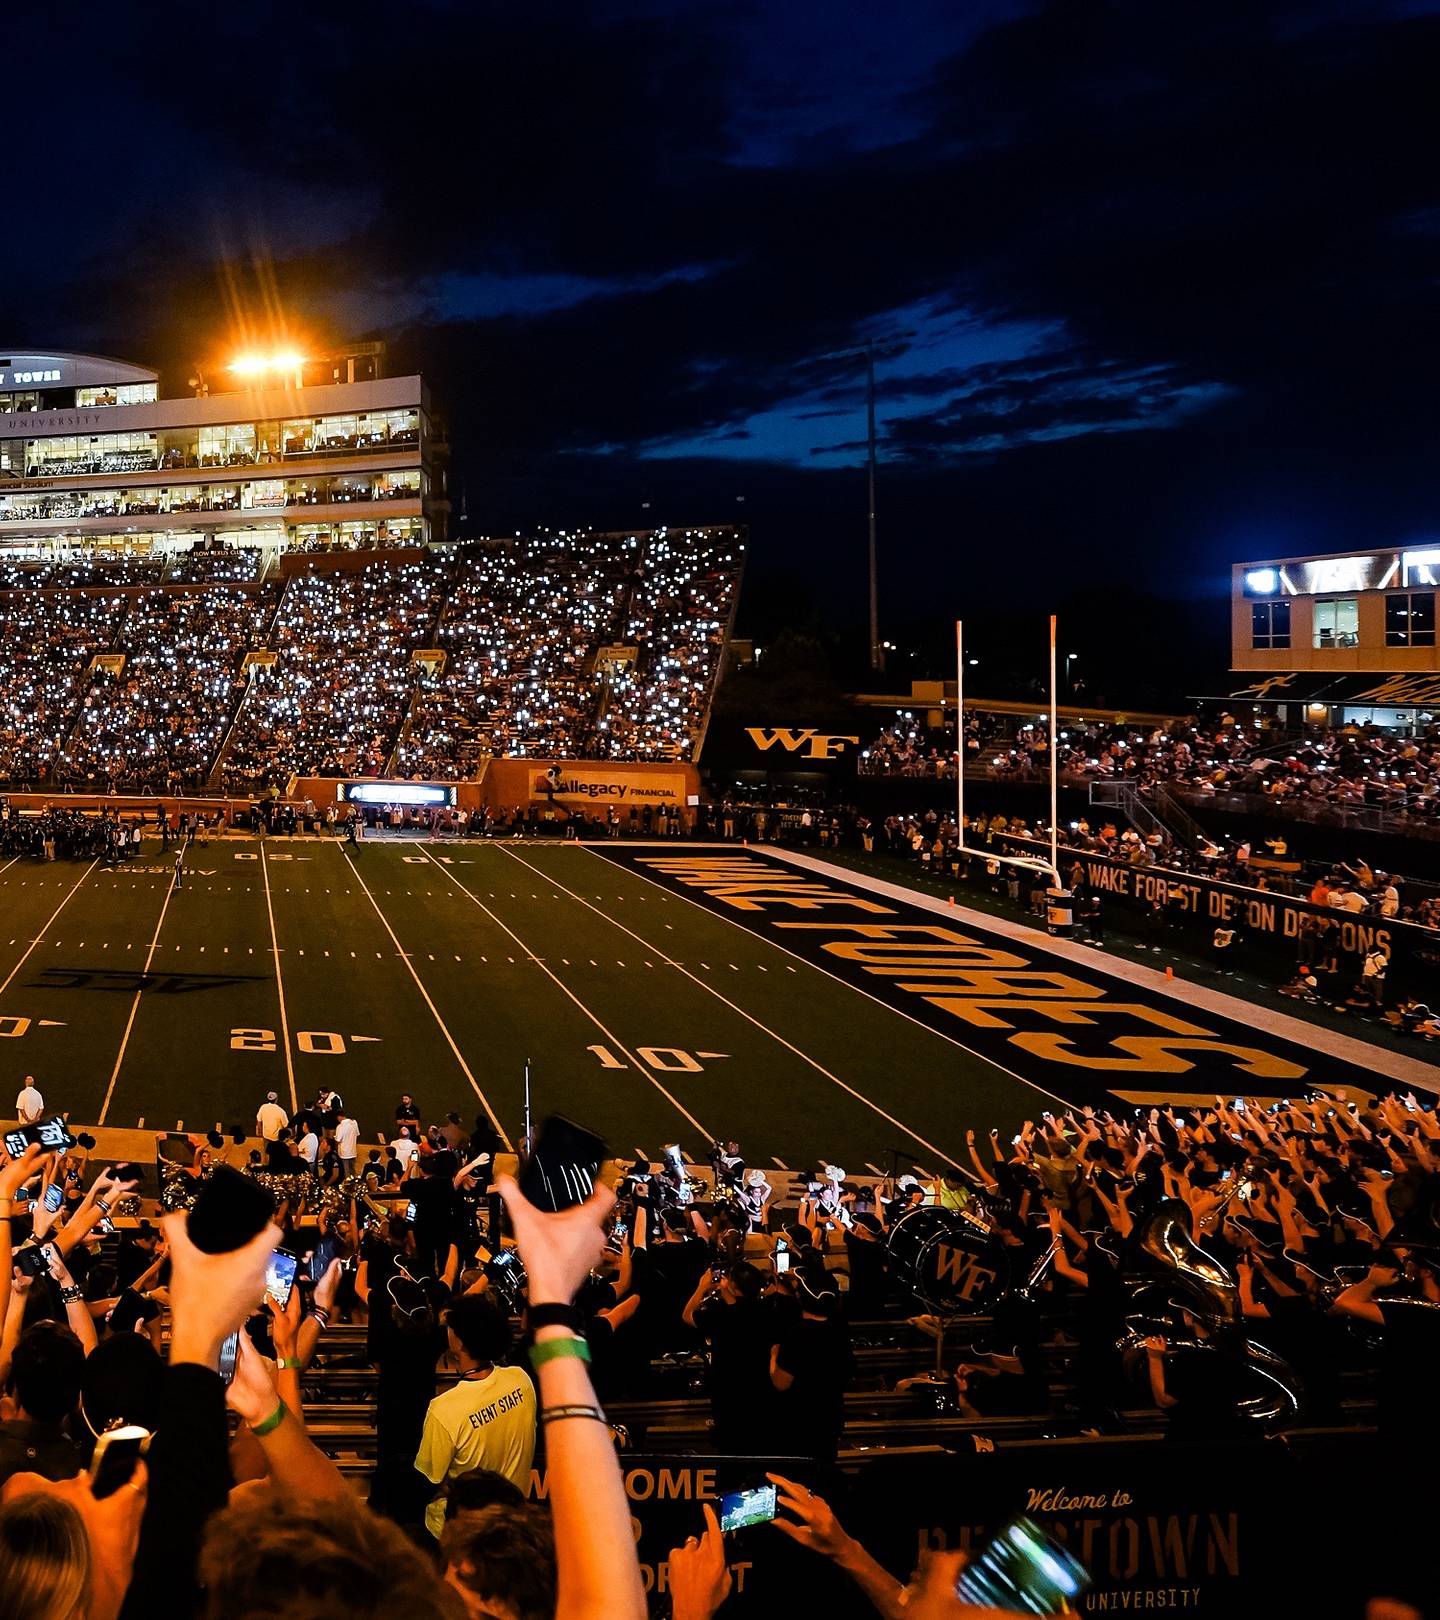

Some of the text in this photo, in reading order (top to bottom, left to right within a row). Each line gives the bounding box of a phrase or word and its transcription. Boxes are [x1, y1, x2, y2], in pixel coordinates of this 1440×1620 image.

[14, 370, 61, 383] TOWER
[9, 415, 101, 429] UNIVERSITY
[22, 480, 54, 489] Stadium
[744, 727, 860, 759] WF
[561, 779, 677, 798] Allegacy FINANCIAL
[634, 857, 900, 914] WAKE
[1087, 863, 1130, 895] WAKE
[1209, 891, 1277, 933] DEON
[230, 1028, 347, 1054] 20
[586, 1045, 705, 1073] 10
[936, 1242, 998, 1302] WF
[468, 1387, 524, 1430] EVENT STAFF
[1025, 1487, 1134, 1512] Welcome to
[1086, 1586, 1202, 1611] UNIVERSITY
